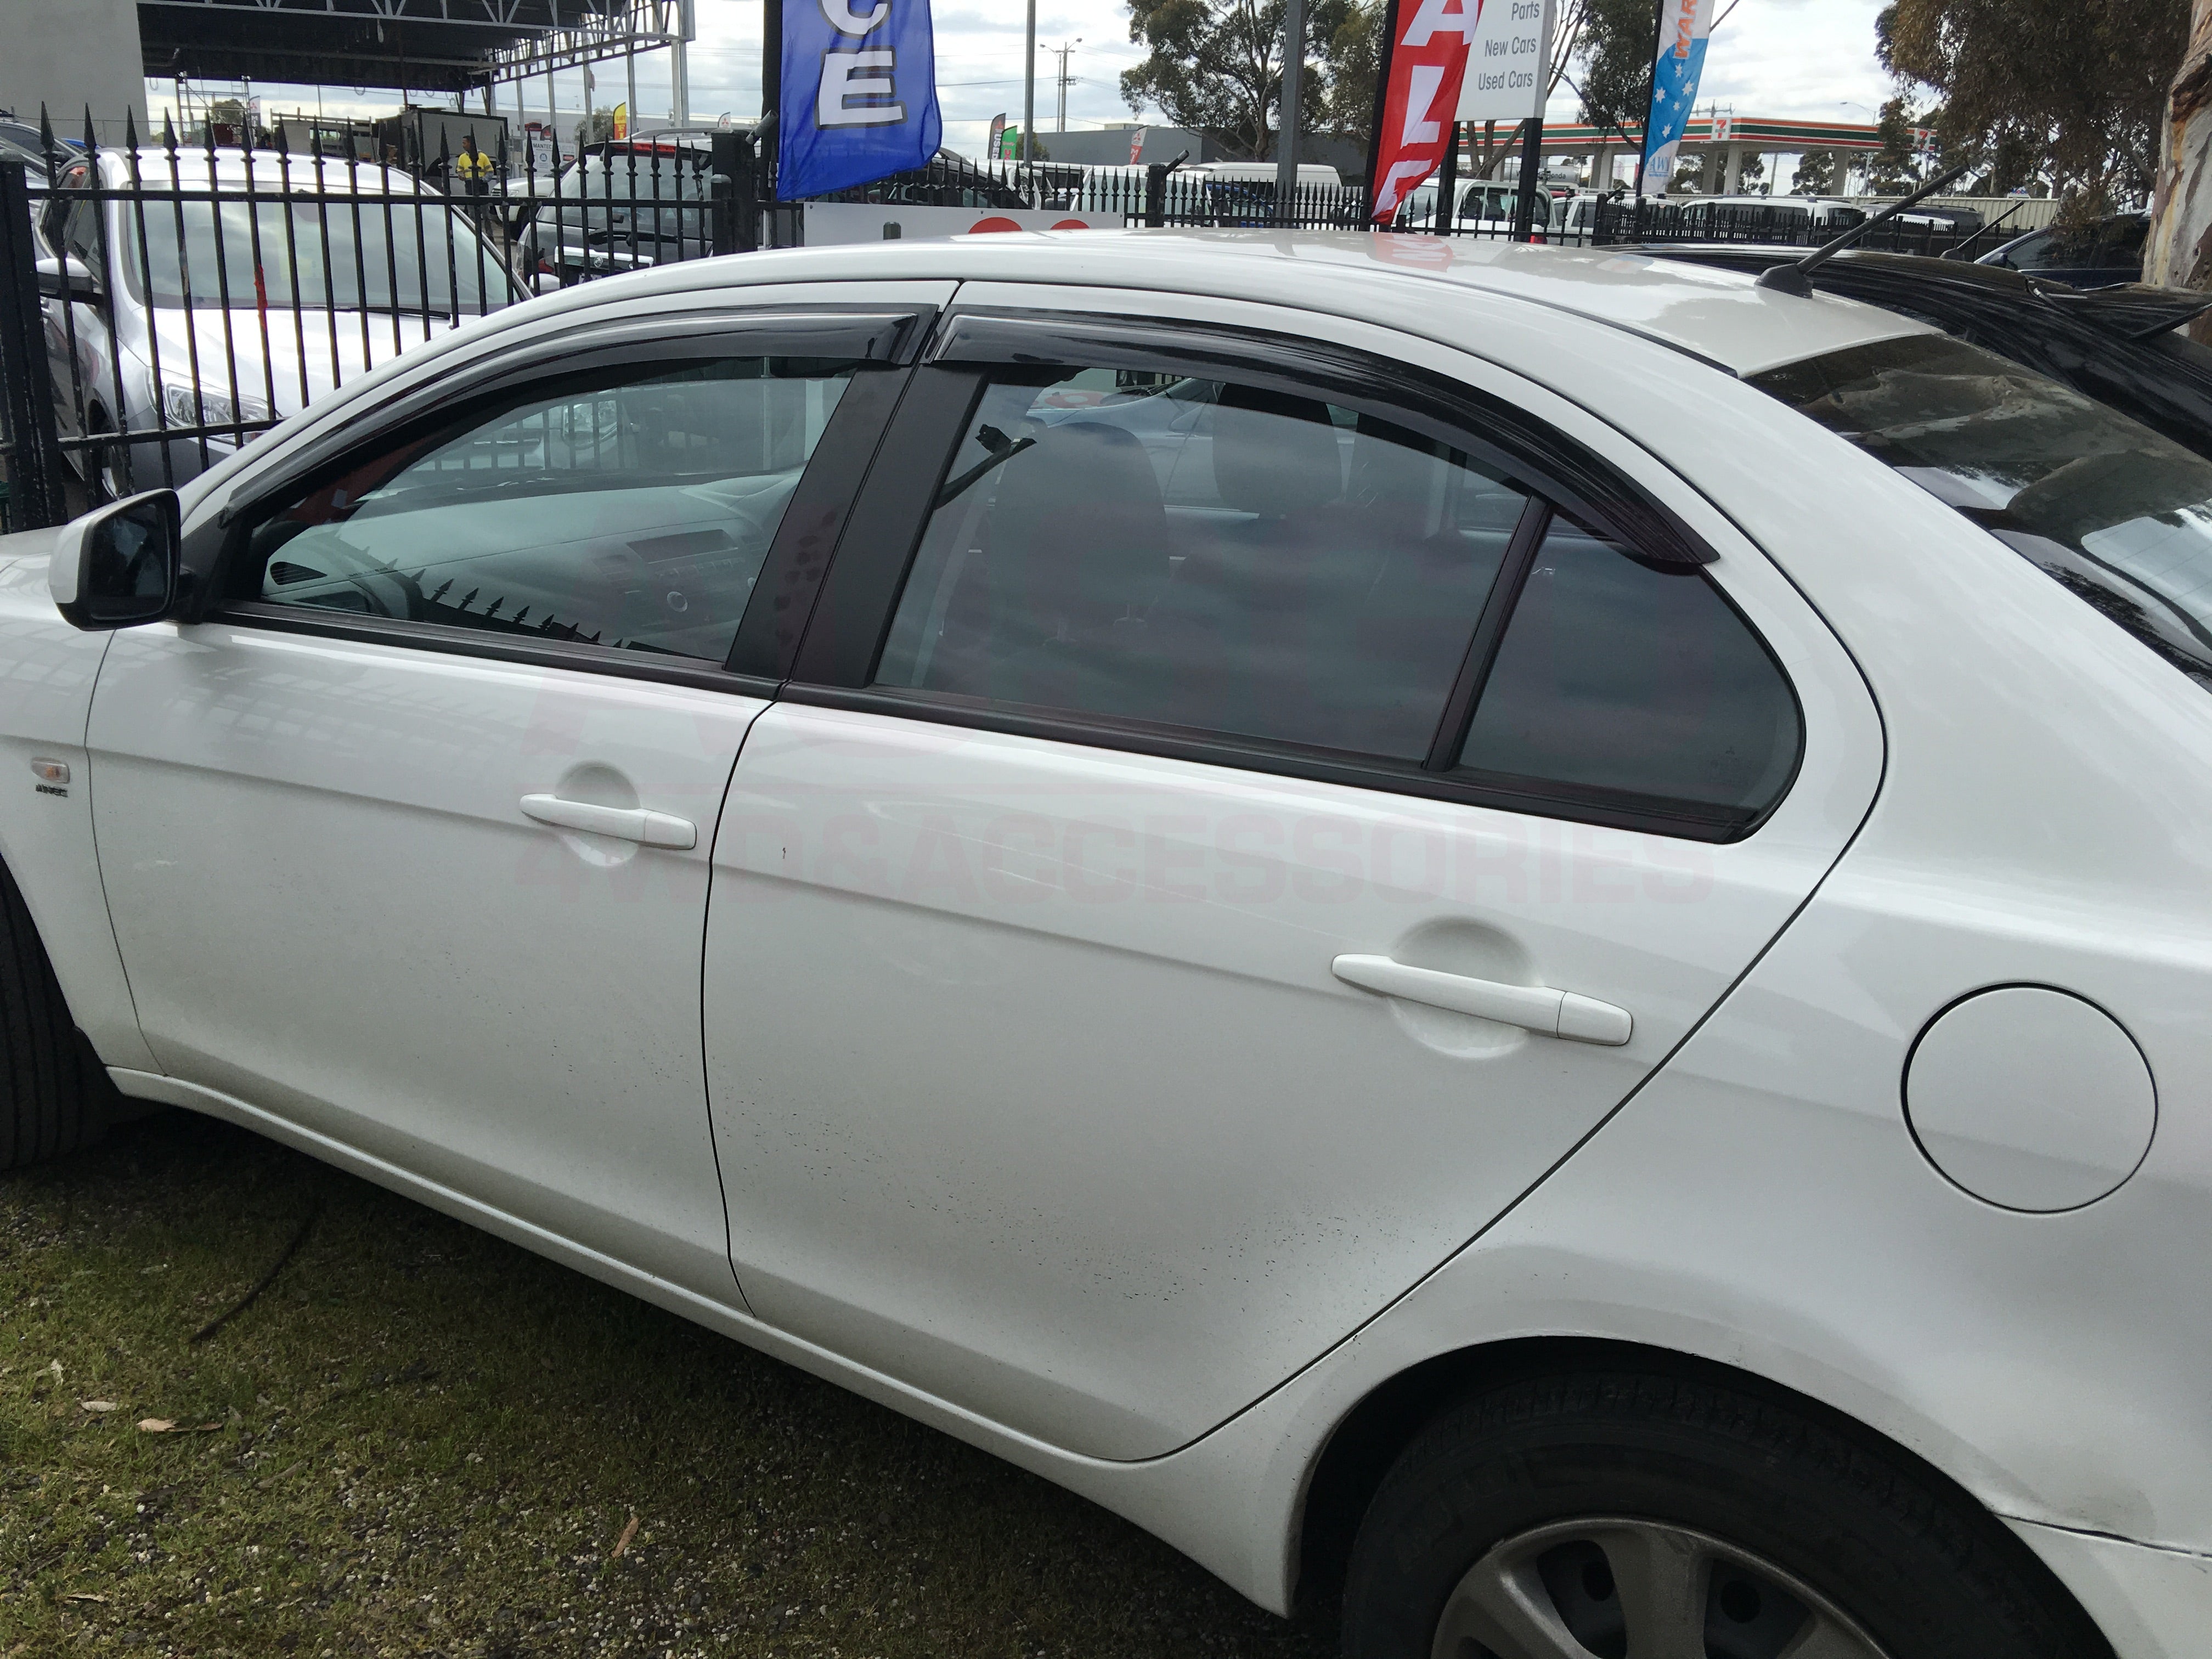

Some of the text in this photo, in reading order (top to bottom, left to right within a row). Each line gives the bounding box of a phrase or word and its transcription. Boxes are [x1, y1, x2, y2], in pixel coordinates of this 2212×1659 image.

[1511, 1, 1540, 21] Parts
[1485, 36, 1537, 57] New Cars
[1479, 70, 1533, 91] Used Cars
[1716, 119, 1726, 139] 7
[992, 133, 1002, 160] USED
